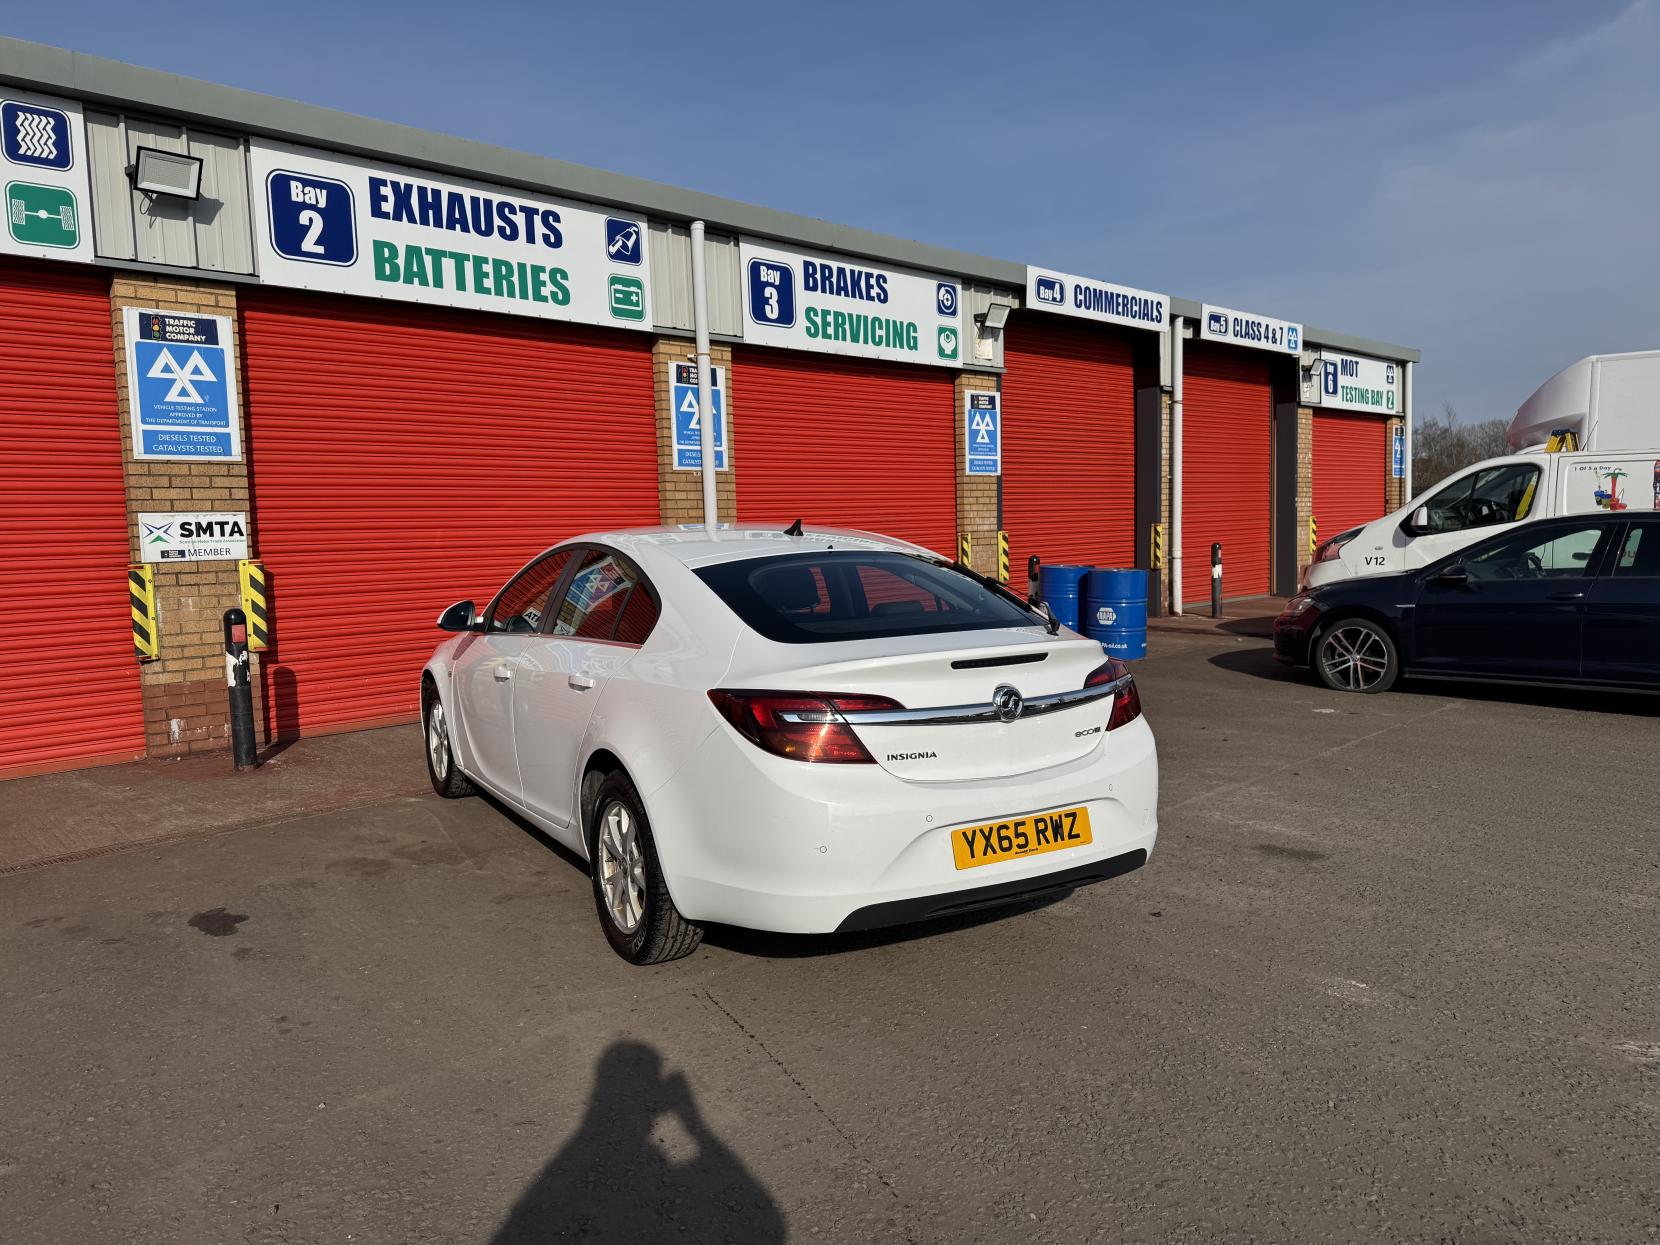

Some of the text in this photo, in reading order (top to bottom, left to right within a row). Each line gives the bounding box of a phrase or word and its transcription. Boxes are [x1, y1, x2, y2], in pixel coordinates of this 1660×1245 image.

[290, 180, 327, 209] Bay
[368, 176, 563, 249] EXHAUSTS
[299, 210, 325, 254] 2
[372, 239, 570, 306] BATTERIES
[760, 265, 780, 286] Bay
[803, 260, 889, 304] BRAKES
[1040, 283, 1060, 301] Bay 4
[764, 287, 779, 320] 3
[1074, 284, 1162, 324] COMMERCIALS
[165, 318, 196, 327] TRAFFIC
[166, 326, 195, 334] MOTOR
[804, 306, 918, 351] SERVICING
[1220, 316, 1226, 333] 5
[1233, 318, 1284, 345] CLASS 4 & 7
[166, 333, 206, 342] COMPANY
[1340, 358, 1359, 378] MOT
[1328, 374, 1334, 393] 6
[1341, 386, 1370, 405] TESTING
[1371, 390, 1383, 406] BAY
[180, 521, 244, 538] SMTA
[188, 548, 231, 557] MEMBER
[1365, 556, 1385, 566] V12
[1099, 611, 1114, 621] NAPA
[886, 751, 937, 762] INSIGNIA
[962, 811, 1080, 859] YX65 RWZ
